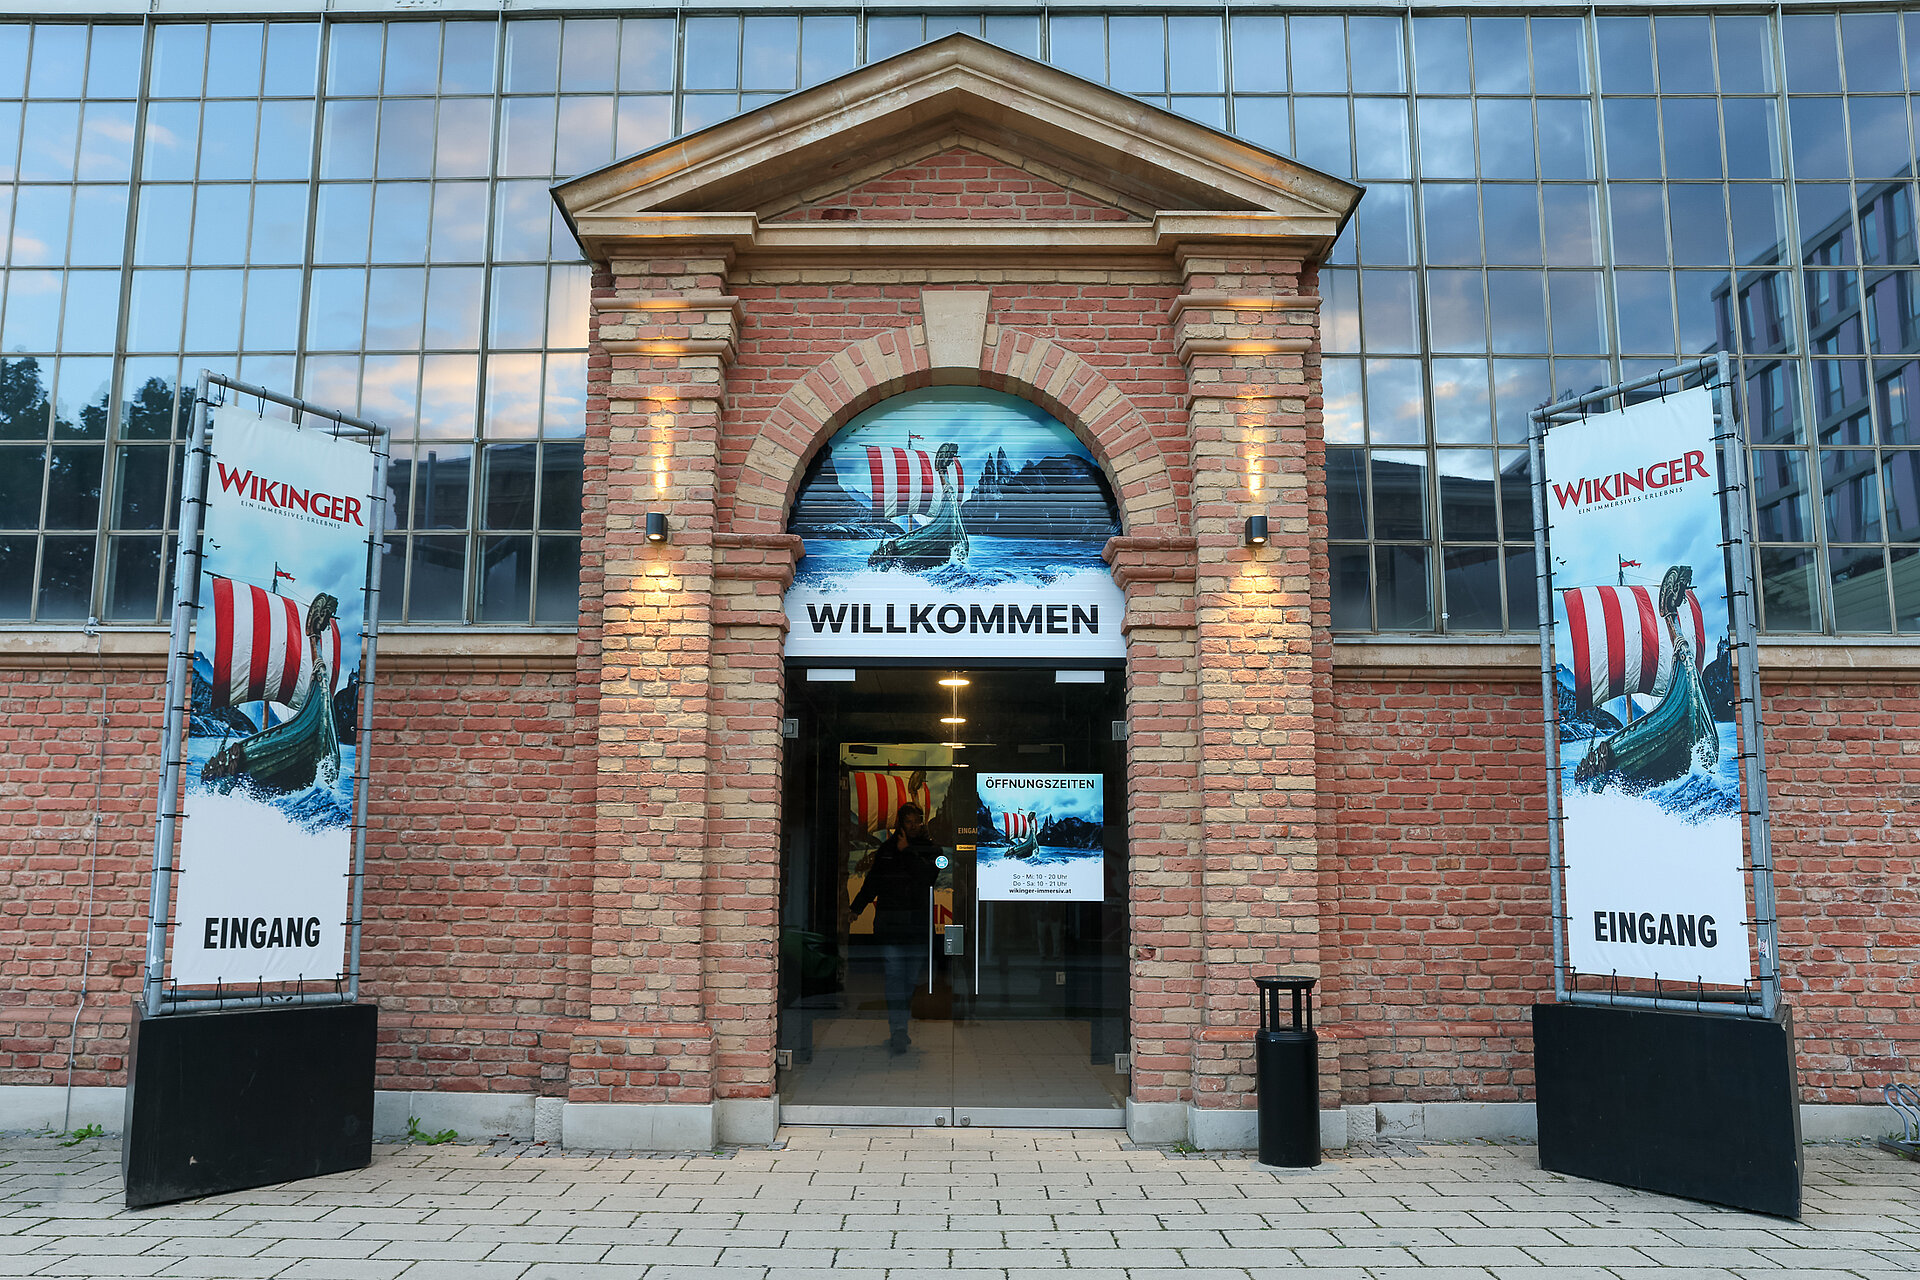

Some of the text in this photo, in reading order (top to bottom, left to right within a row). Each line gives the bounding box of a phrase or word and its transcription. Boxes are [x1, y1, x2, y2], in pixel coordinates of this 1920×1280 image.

[217, 461, 364, 527] WIKINGER
[1552, 449, 1710, 511] WIKINGER
[241, 500, 341, 530] EIN IMMERSIVES ERLEBNIS
[1579, 487, 1683, 515] EIN IMMERSIVES ERLEBNIS
[806, 603, 1099, 635] WILLKOMMEN
[985, 776, 1095, 789] ÖFFNUNGSZEITEN
[203, 916, 321, 950] EINGANG
[1593, 910, 1718, 949] EINGANG
